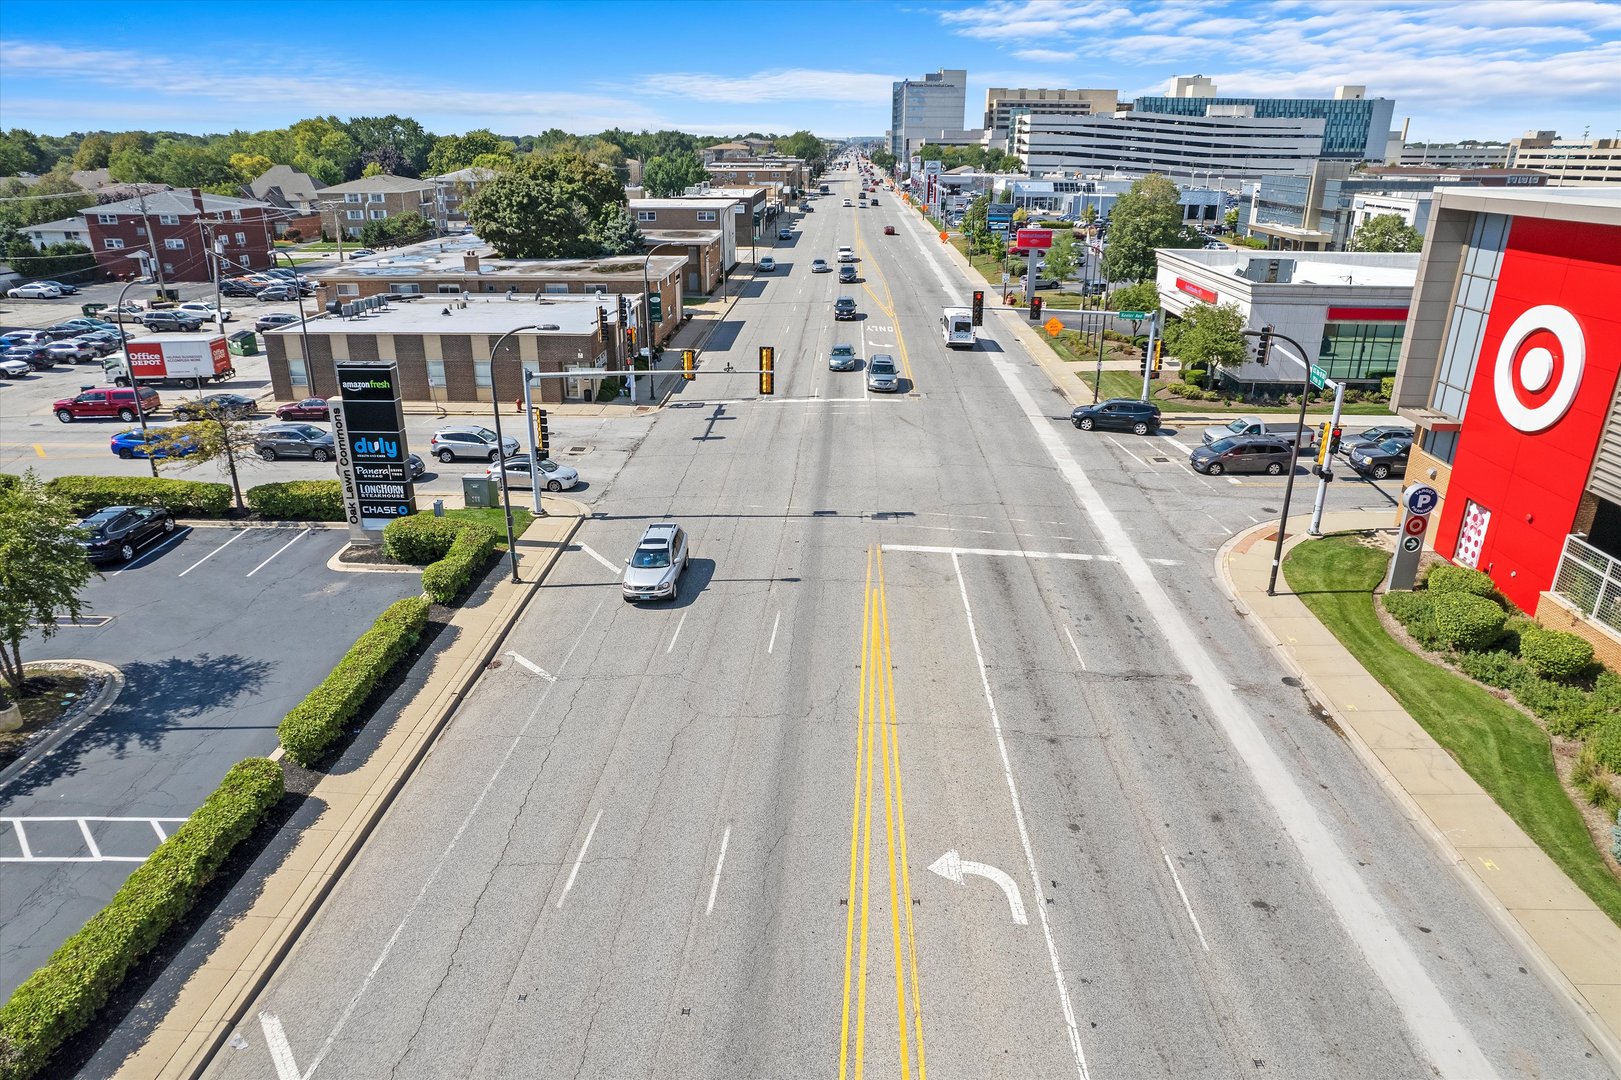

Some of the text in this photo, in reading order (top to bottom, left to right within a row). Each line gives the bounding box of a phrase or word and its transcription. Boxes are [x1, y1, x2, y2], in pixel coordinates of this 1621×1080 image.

[866, 325, 894, 333] ONLY
[129, 352, 160, 360] Office
[354, 437, 398, 458] duly
[333, 407, 359, 525] Oak Lawn Commons
[355, 466, 389, 475] Panera
[1416, 494, 1431, 508] P
[362, 505, 398, 514] CHASE
[1411, 505, 1433, 513] PARKING
